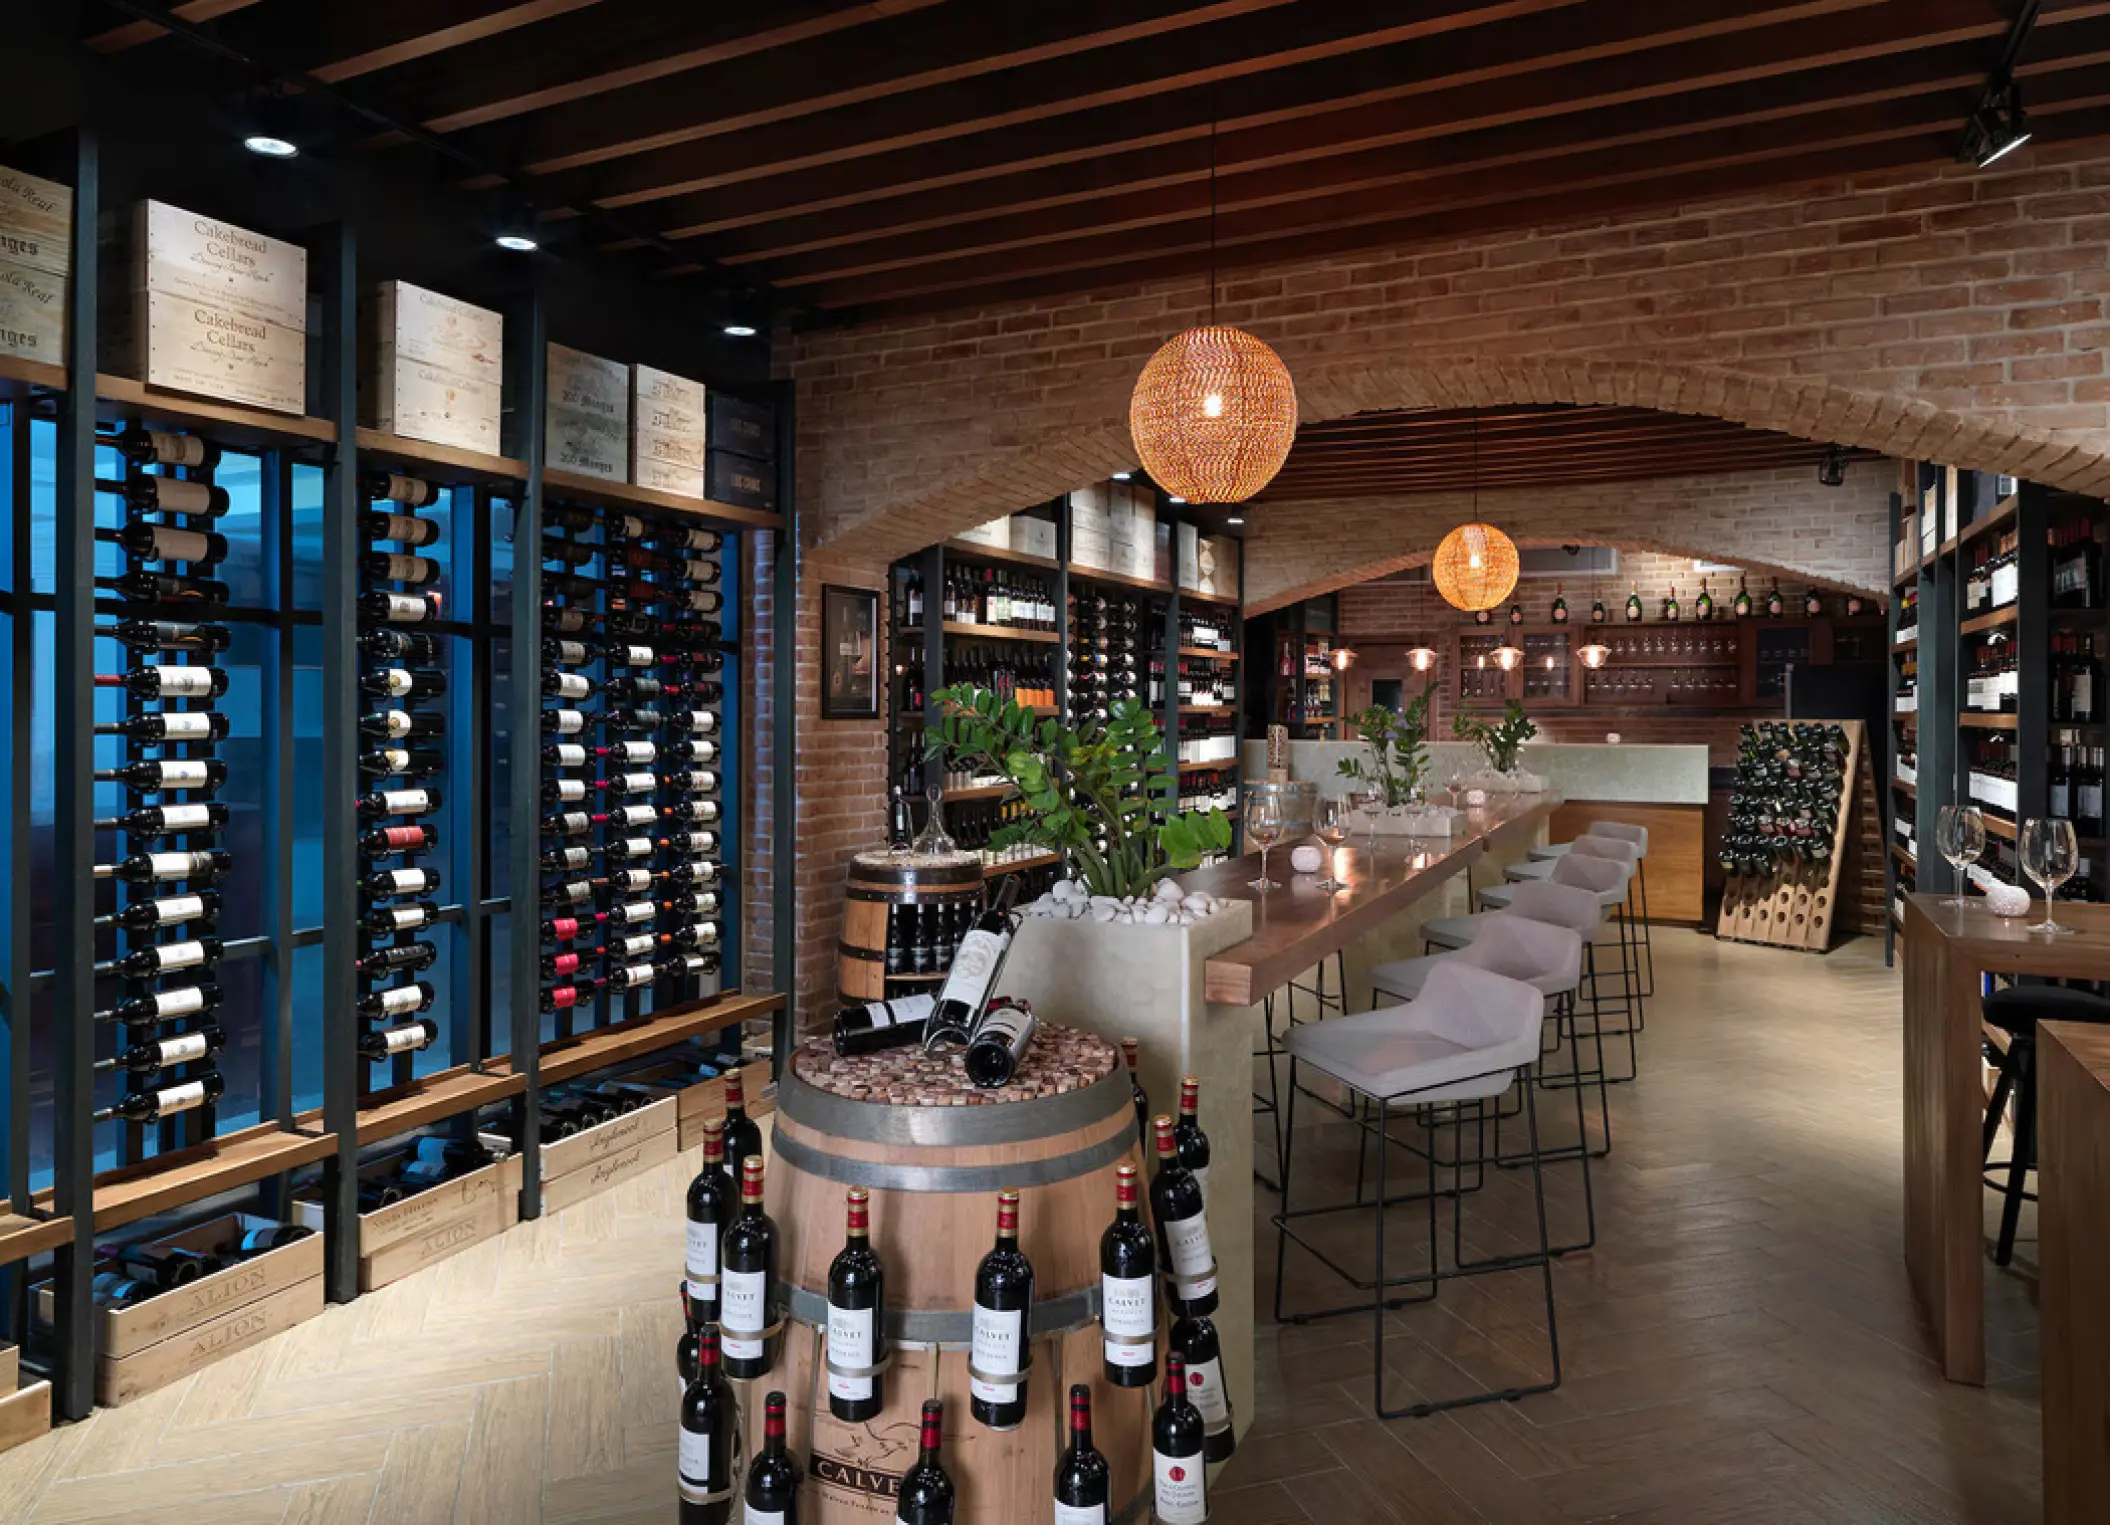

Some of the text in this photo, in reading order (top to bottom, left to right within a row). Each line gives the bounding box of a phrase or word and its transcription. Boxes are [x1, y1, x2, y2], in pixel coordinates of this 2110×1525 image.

[194, 220, 268, 254] Cakebread
[206, 241, 257, 267] Cellars
[194, 304, 267, 340] Cakebread
[206, 328, 257, 352] Cellars
[188, 1266, 268, 1311] ALION
[189, 1310, 268, 1357] ALION
